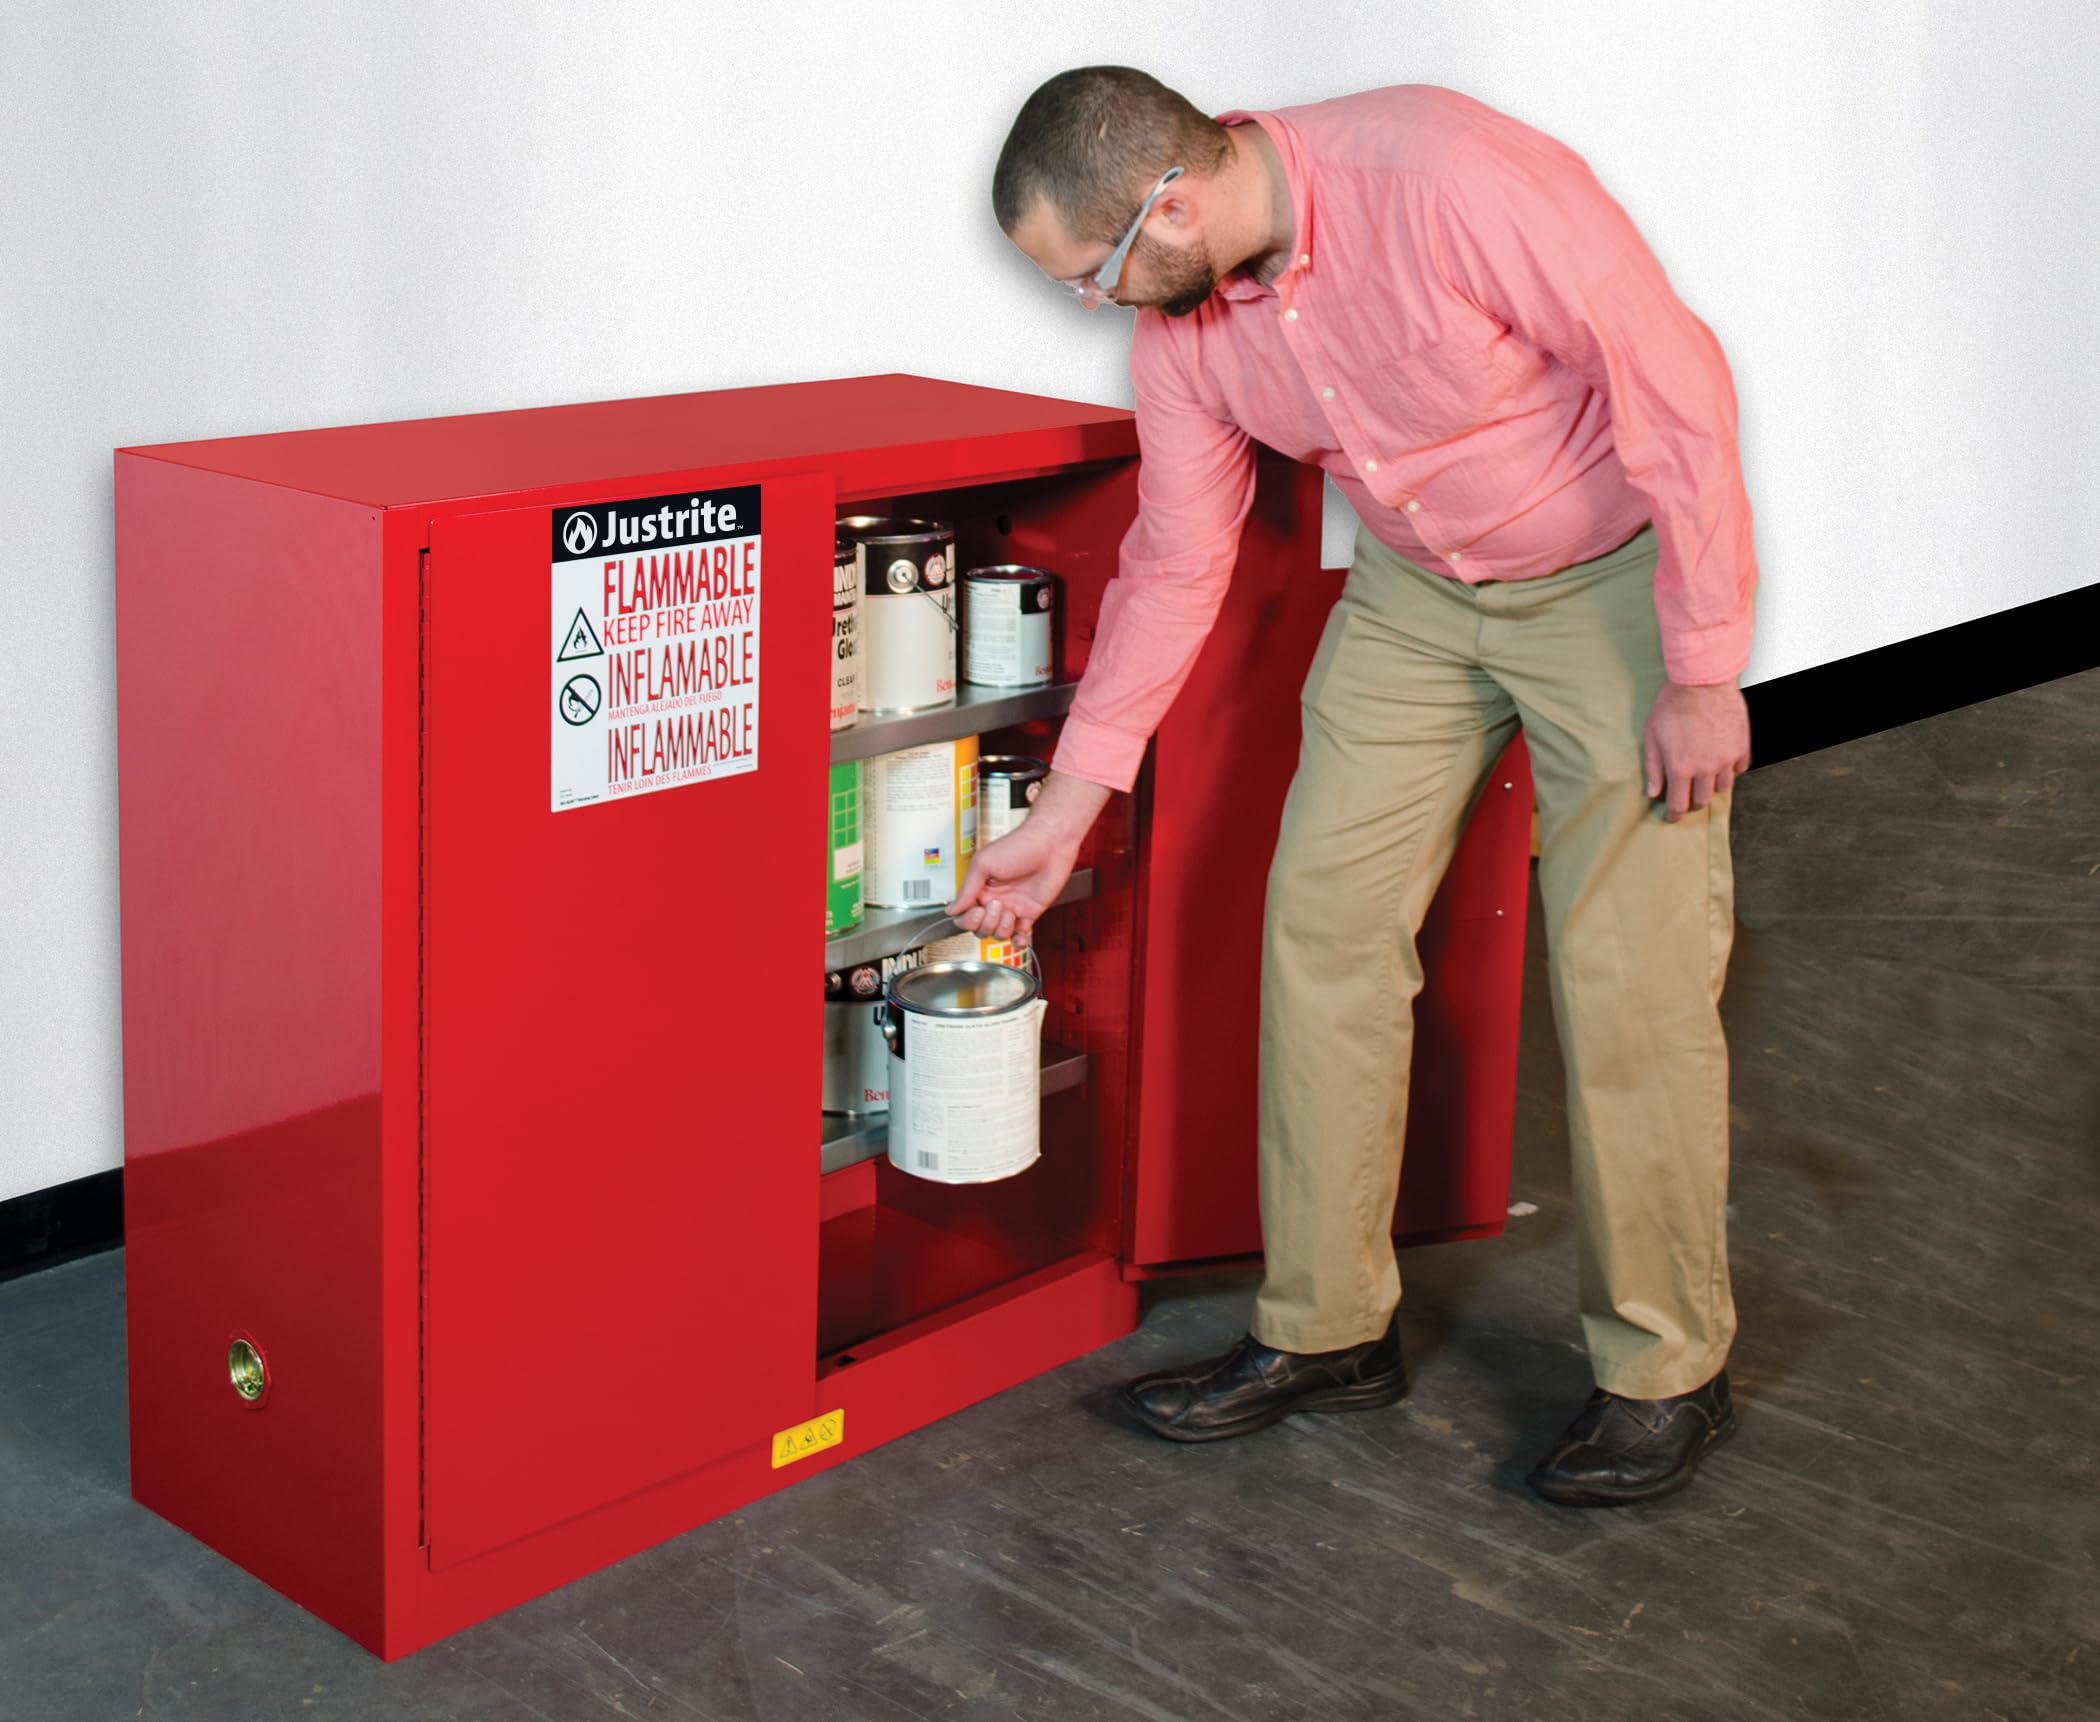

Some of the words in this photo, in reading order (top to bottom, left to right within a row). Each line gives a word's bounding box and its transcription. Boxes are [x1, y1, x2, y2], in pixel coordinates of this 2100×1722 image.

[602, 498, 737, 548] Justrite
[604, 541, 755, 617] FLAMMABLE
[603, 614, 650, 647] KEEP
[656, 606, 695, 638] FIRE
[701, 597, 754, 631] AWAY
[608, 631, 753, 709] INFLAMABLE
[608, 705, 650, 720] MANTENGA
[651, 698, 682, 713] ALEJADO
[685, 695, 697, 706] DEL
[701, 690, 722, 703] FUEGO
[608, 702, 753, 783] INFLAMMABLE
[608, 781, 633, 795] TENIR
[634, 777, 653, 790] LOIN
[656, 774, 671, 786] DES
[673, 765, 712, 782] FLAMMES
